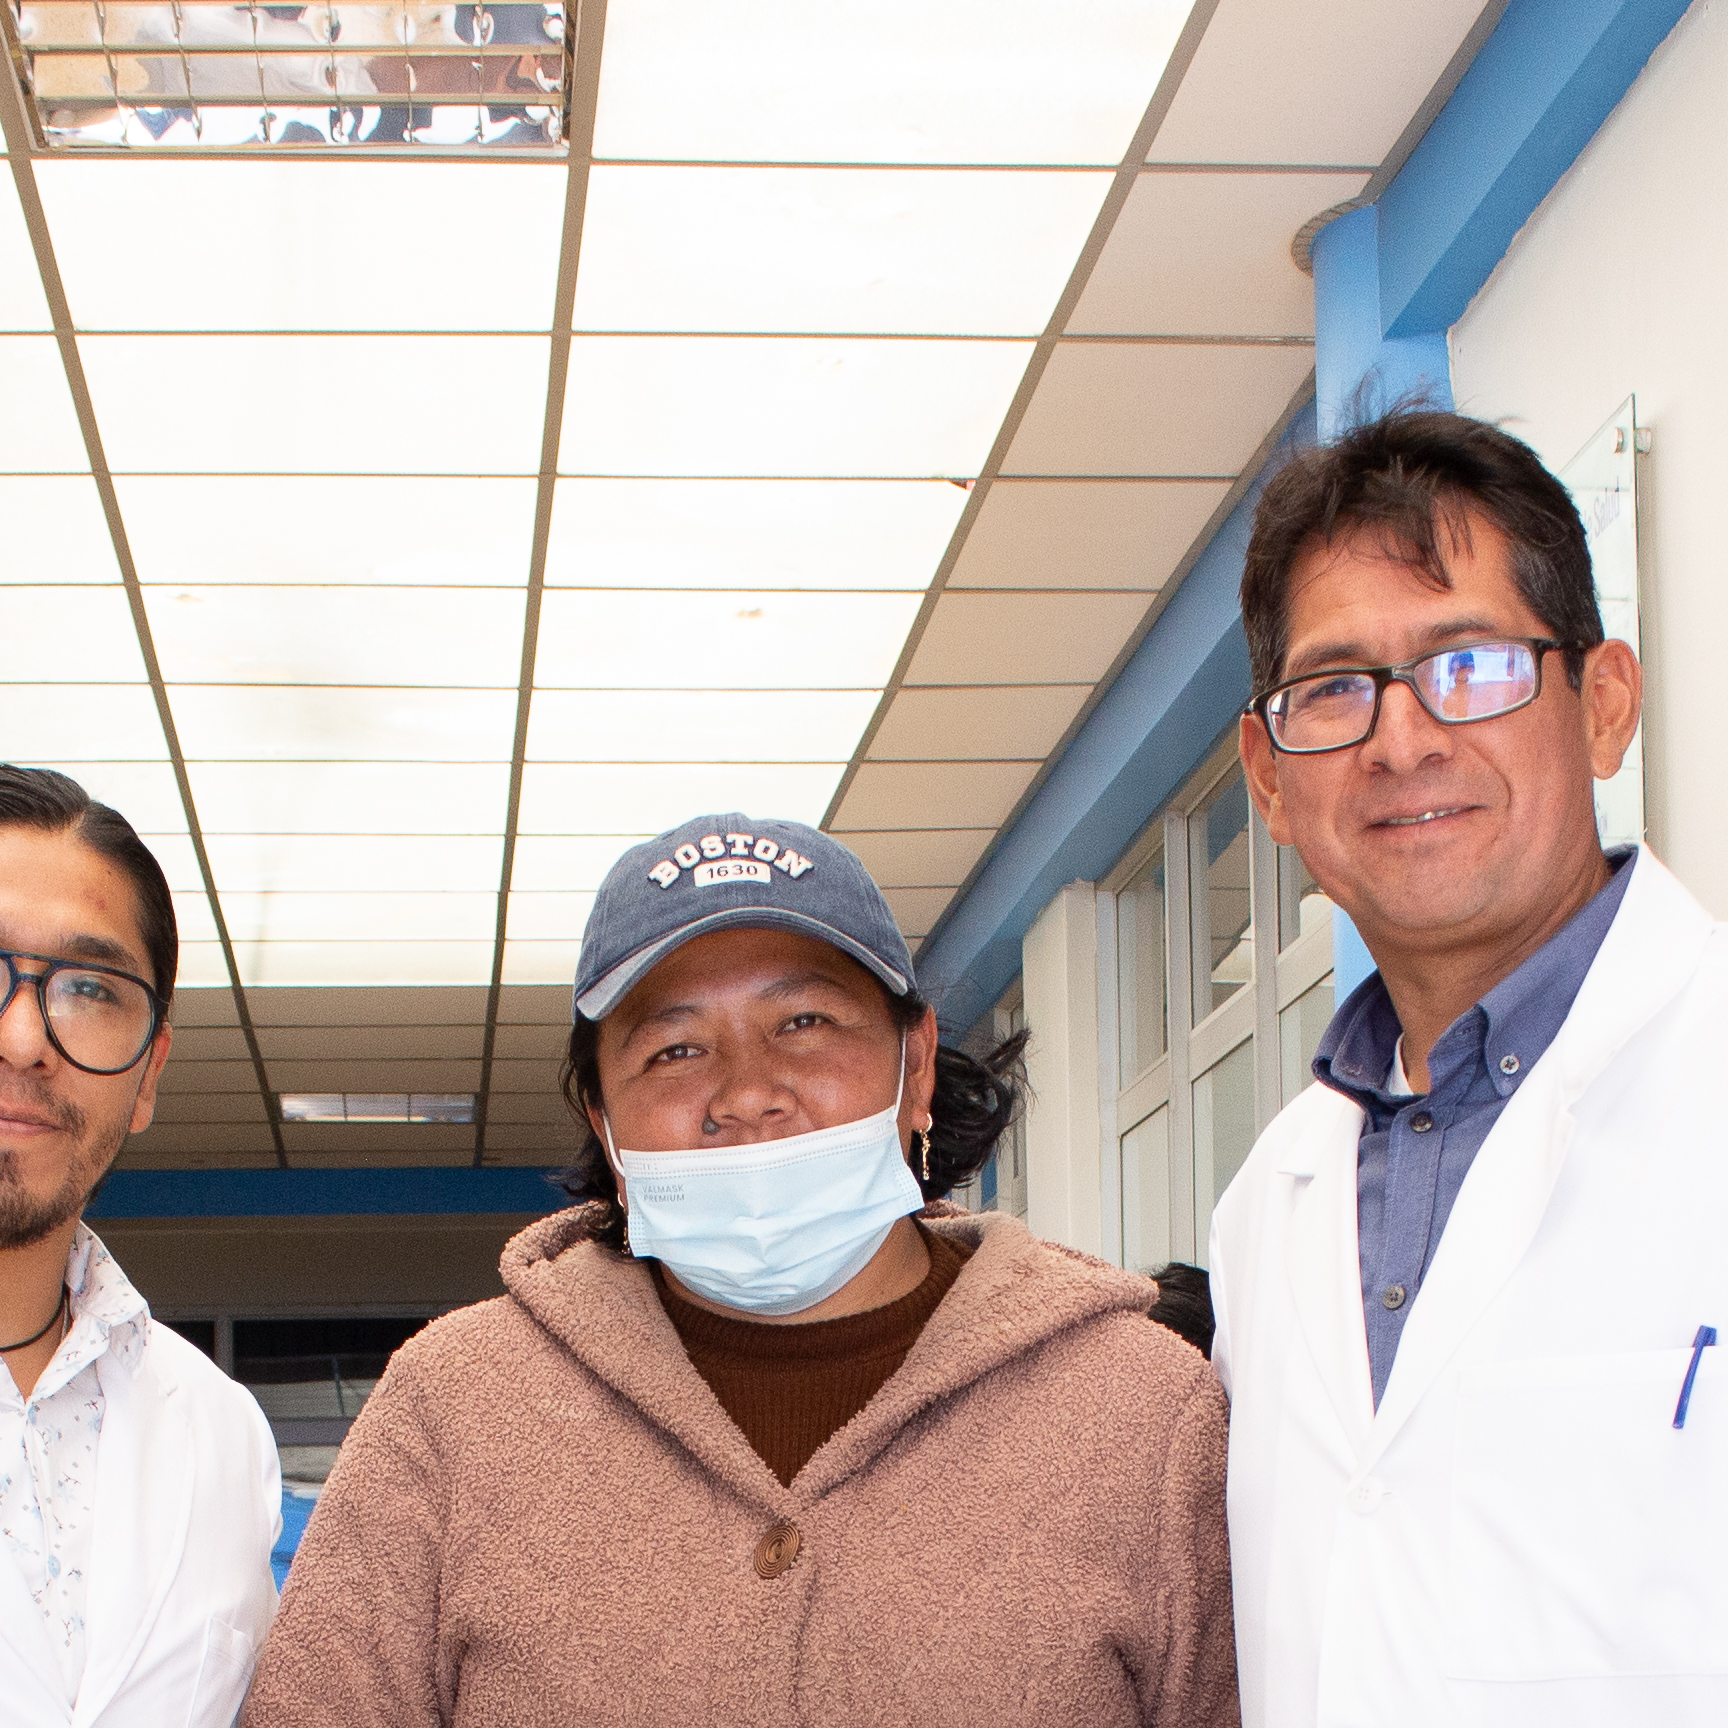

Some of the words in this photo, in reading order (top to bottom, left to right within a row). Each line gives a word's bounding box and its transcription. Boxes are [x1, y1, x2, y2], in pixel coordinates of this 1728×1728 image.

[647, 833, 814, 890] BOSTON
[706, 863, 759, 880] 1630
[642, 1183, 685, 1194] VALMASK
[643, 1193, 685, 1203] PREMIUM
